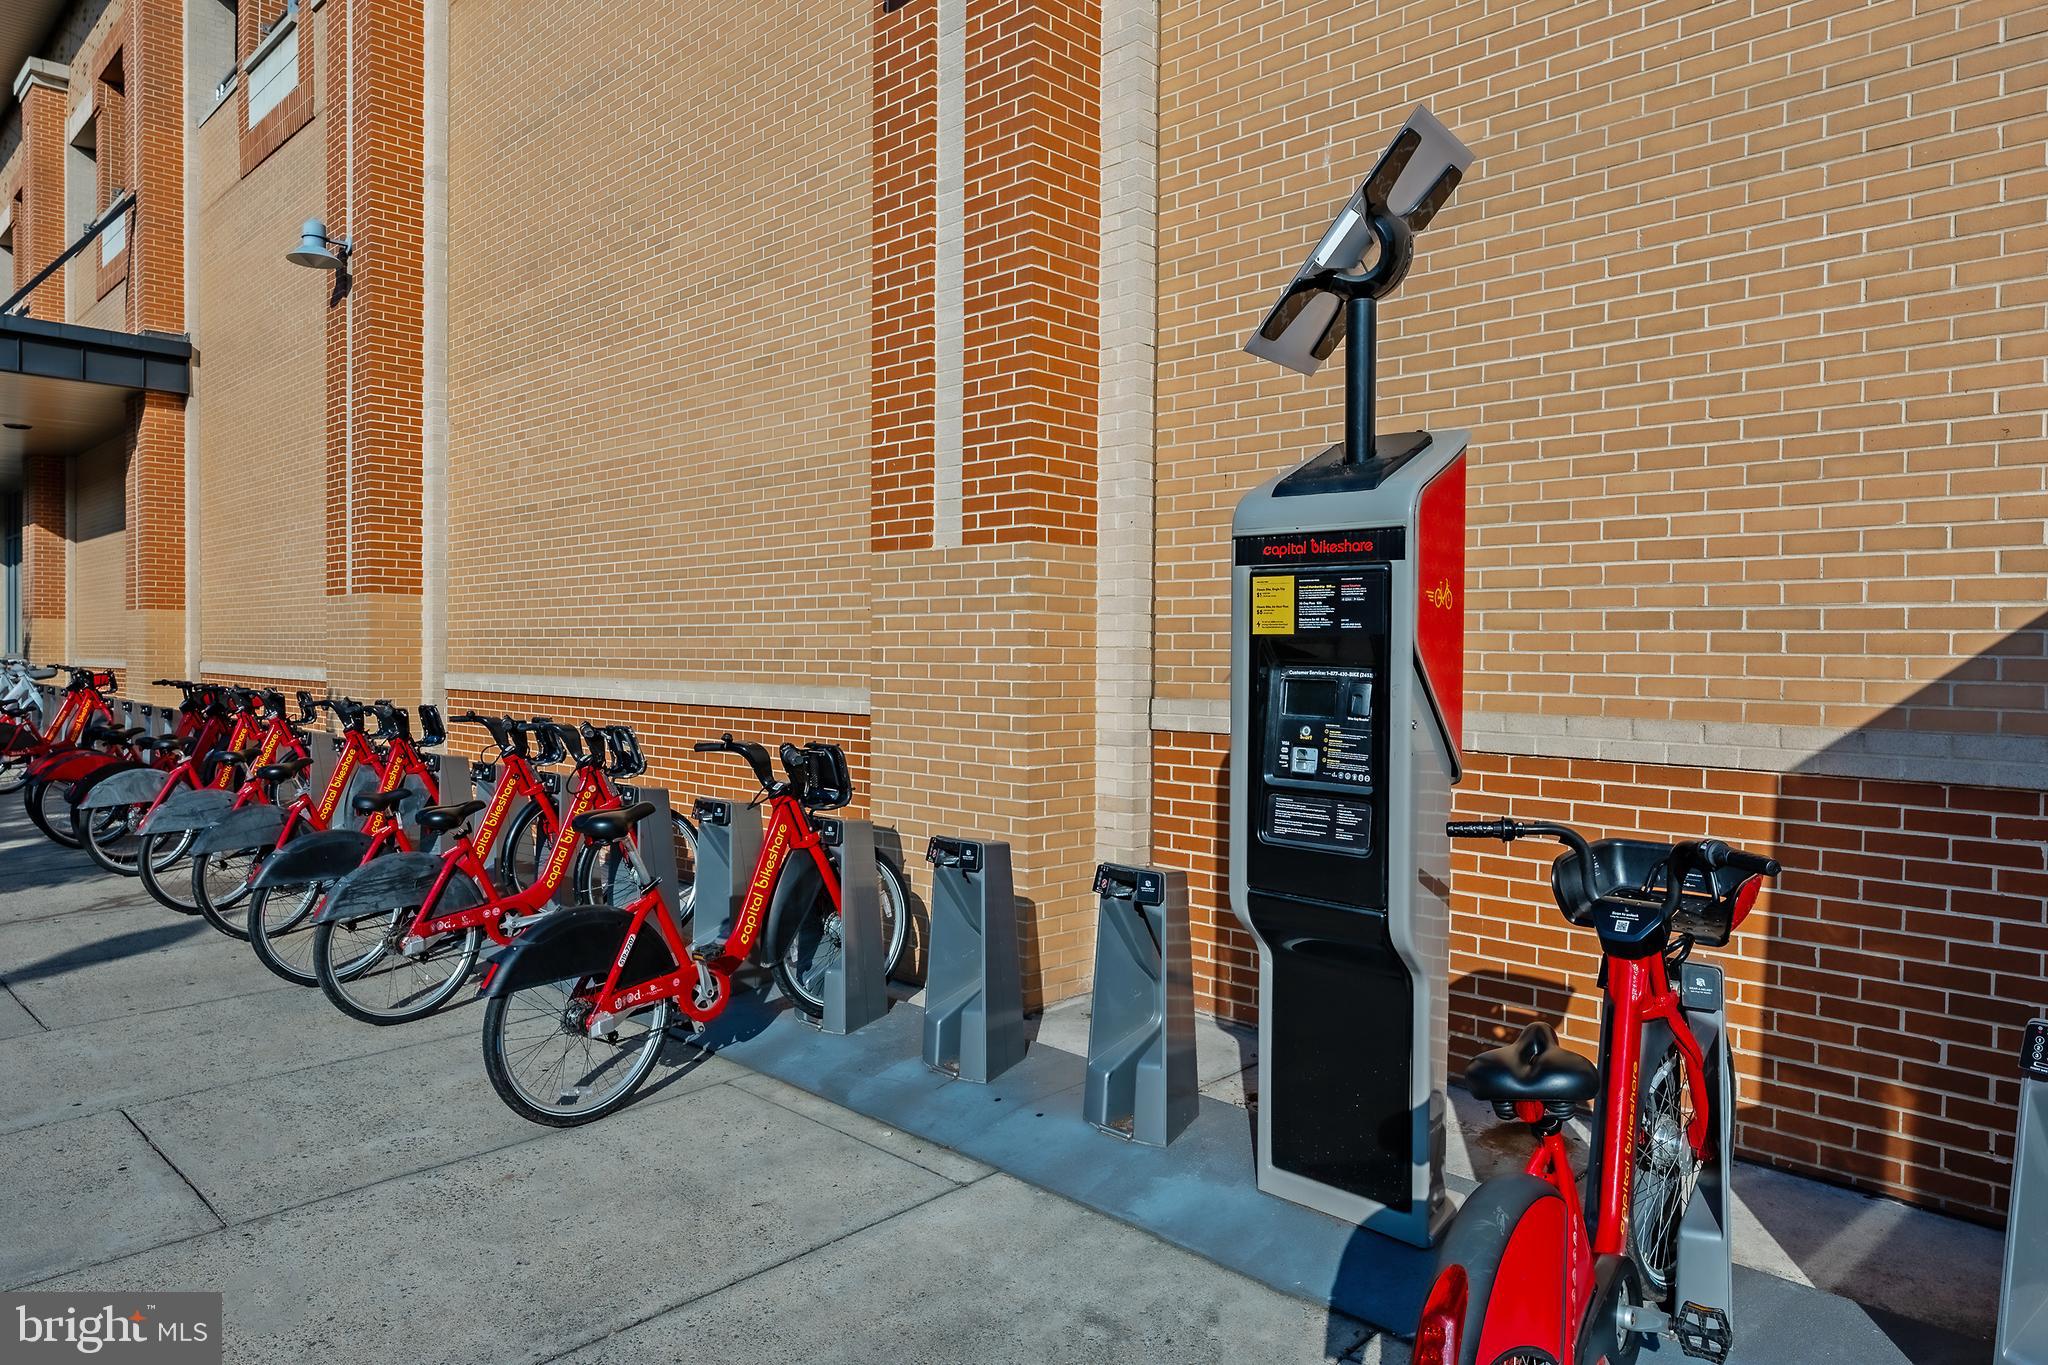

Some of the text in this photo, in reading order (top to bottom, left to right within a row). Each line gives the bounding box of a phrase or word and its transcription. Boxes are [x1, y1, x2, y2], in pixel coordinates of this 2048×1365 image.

[1263, 538, 1374, 558] capital bikeshare
[320, 749, 356, 820] capital bikeshare
[476, 778, 516, 859] pital bikeshare
[371, 811, 384, 833] capi
[546, 846, 568, 888] capital
[740, 824, 787, 944] capital bikeshare
[1624, 1061, 1638, 1155] bikeshare
